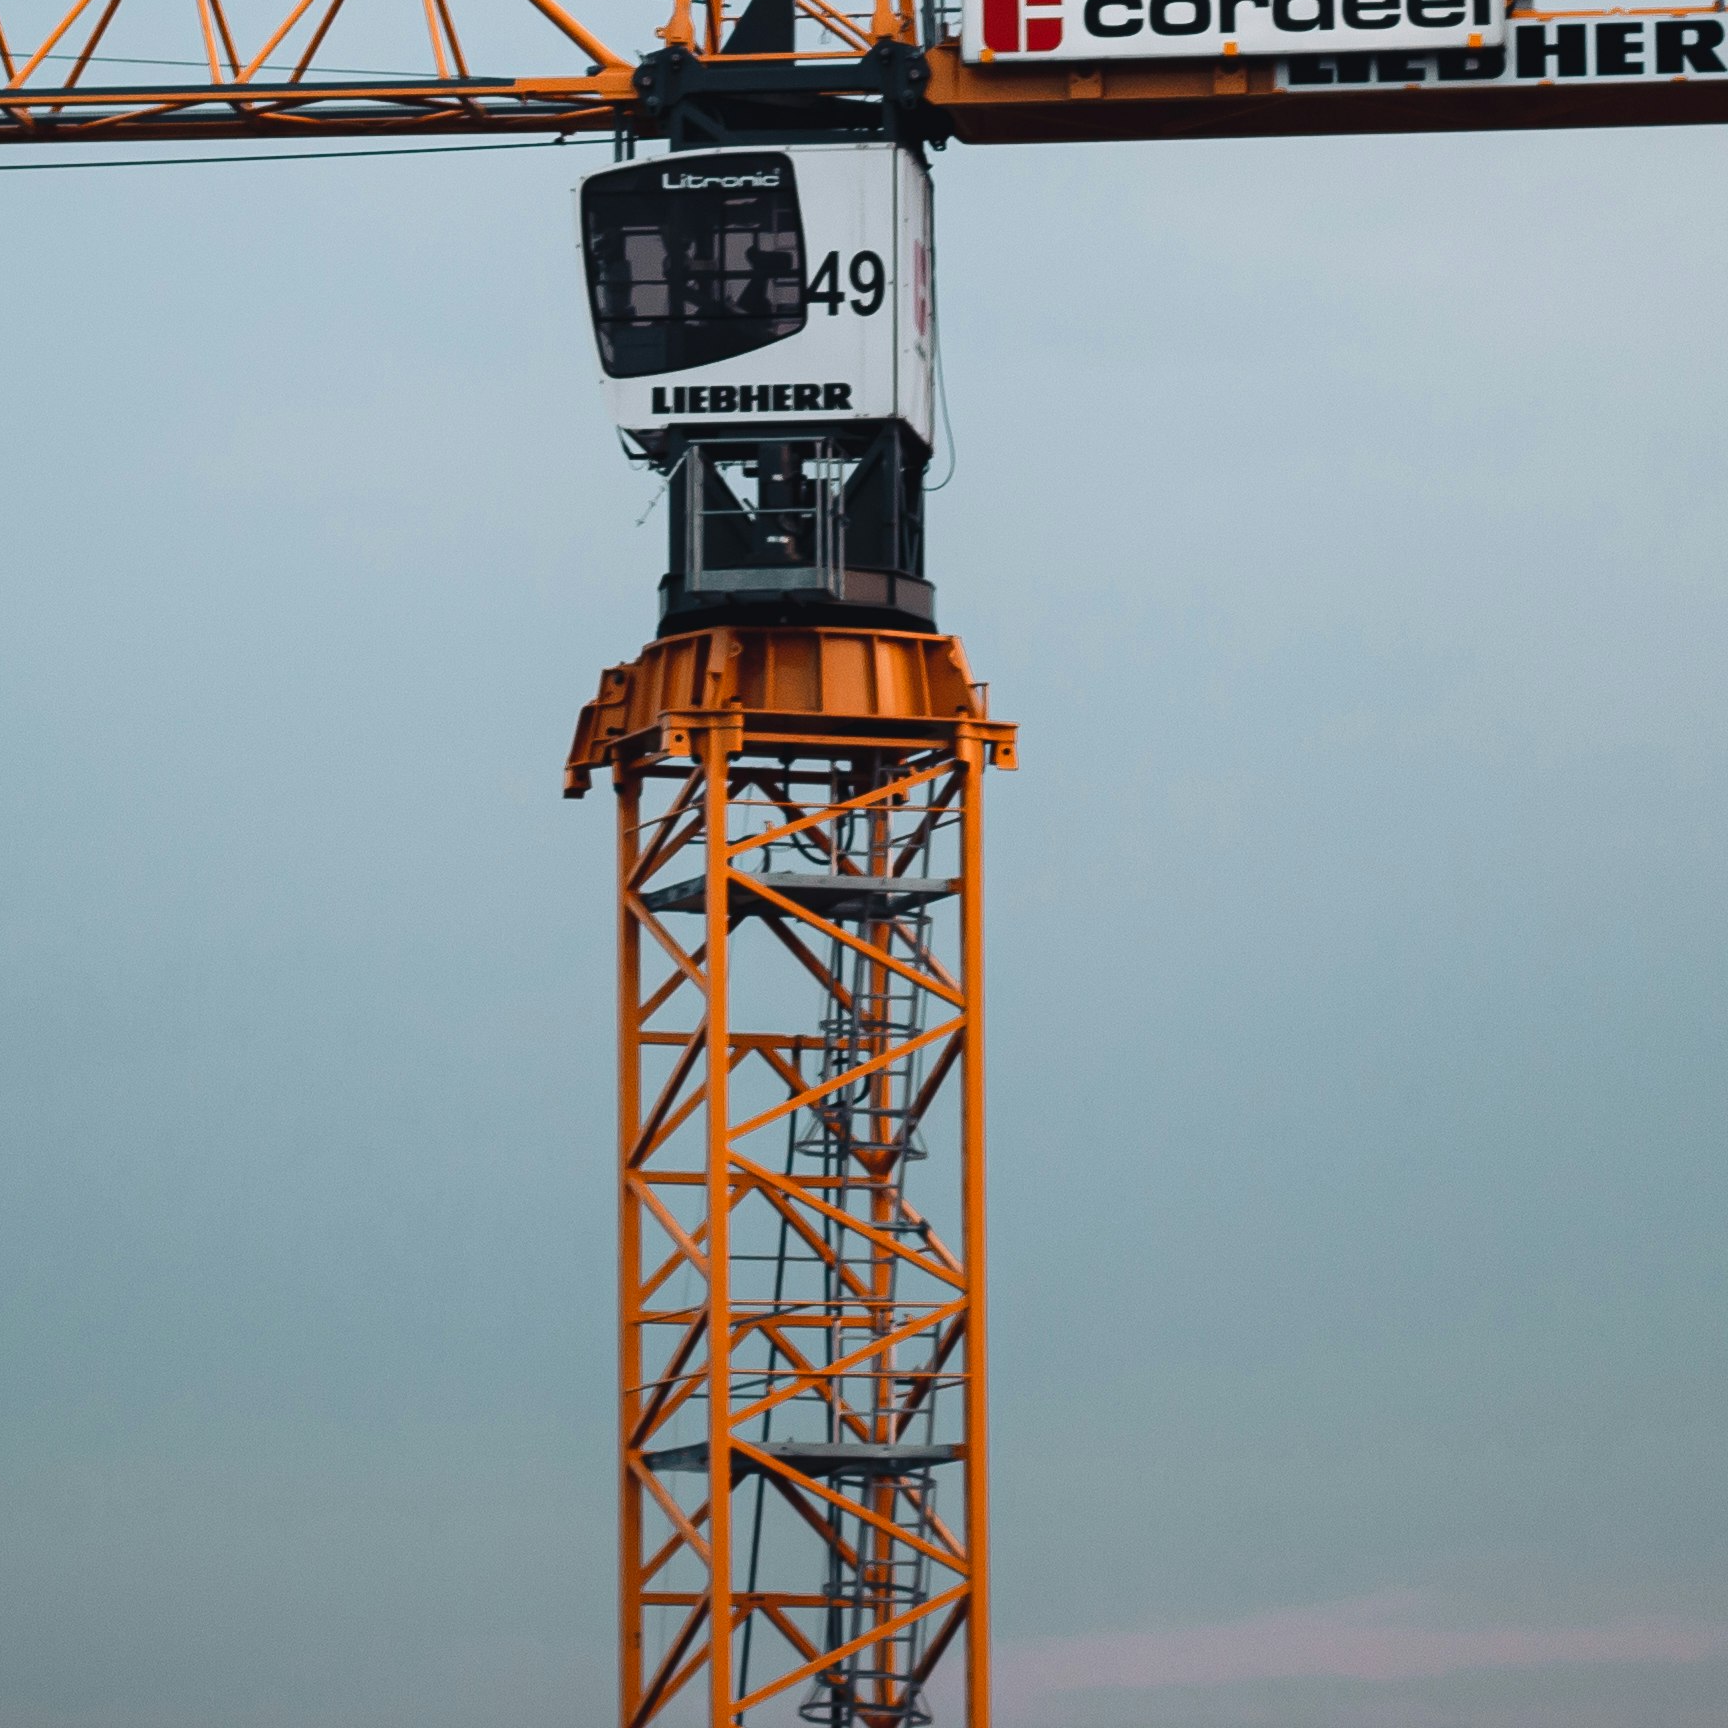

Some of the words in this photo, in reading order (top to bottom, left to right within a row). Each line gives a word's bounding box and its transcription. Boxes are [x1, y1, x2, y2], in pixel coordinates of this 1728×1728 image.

[661, 171, 780, 190] Litronic
[806, 250, 885, 317] 49
[652, 382, 853, 415] LIEBHERR
